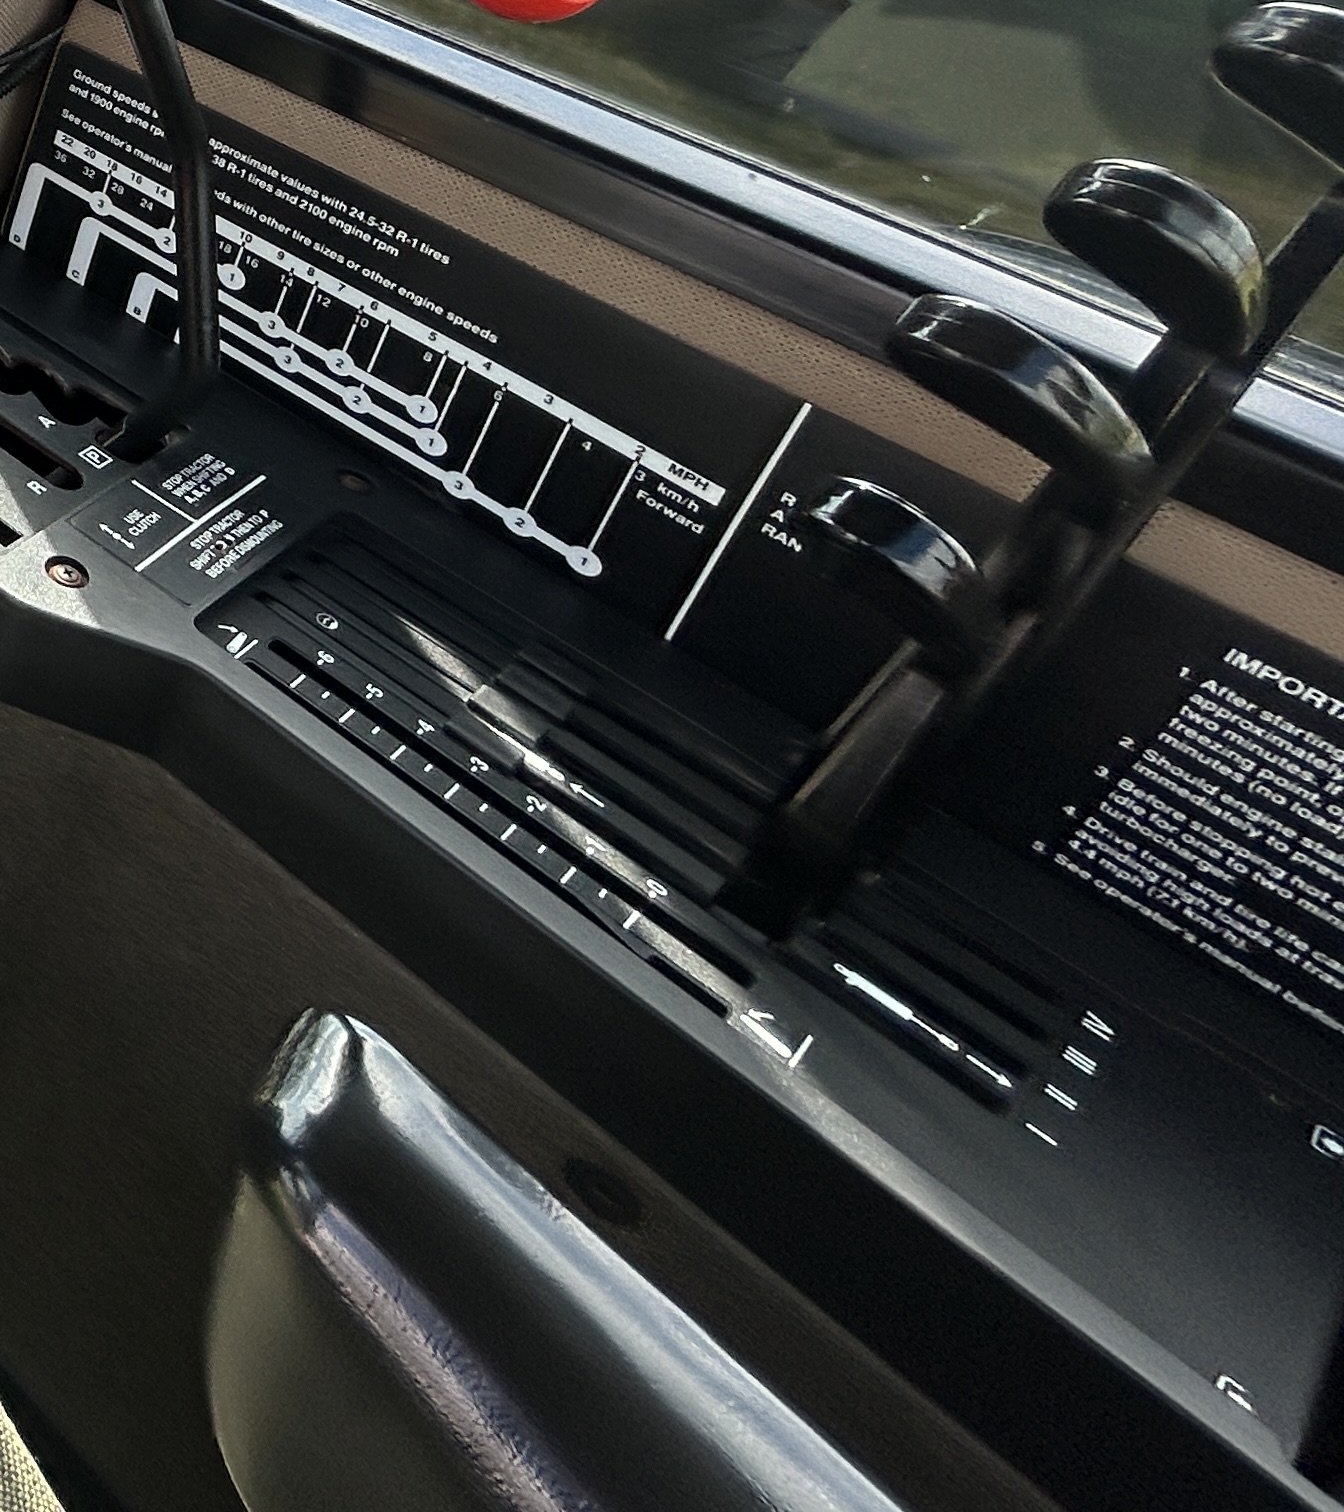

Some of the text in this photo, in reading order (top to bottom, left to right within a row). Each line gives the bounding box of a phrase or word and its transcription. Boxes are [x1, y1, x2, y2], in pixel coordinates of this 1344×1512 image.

[68, 83, 89, 98] and
[89, 92, 113, 110] 1900
[113, 106, 150, 129] engine
[226, 161, 247, 180] R-1
[247, 172, 274, 194] tires
[274, 186, 298, 205] and
[298, 198, 327, 220] 2100
[328, 214, 371, 243] engine
[373, 236, 400, 258] rpm
[73, 68, 451, 265] Ground speeds approximate values with 24.5-32 R-1 tires
[61, 108, 499, 344] See operator's manual with other tire sizes or other engine speeds
[61, 134, 74, 147] 22
[84, 147, 97, 160] 20
[130, 172, 143, 185] 16
[155, 185, 168, 197] 14
[276, 250, 285, 261] 9
[307, 267, 315, 277] 8
[337, 283, 346, 292] 7
[371, 301, 379, 311] 6
[428, 332, 437, 341] 5
[483, 362, 492, 371] 4
[543, 394, 554, 405] 3
[634, 445, 647, 456] 2
[667, 463, 711, 492] MPH
[82, 166, 96, 179] 32
[140, 198, 154, 211] 24
[245, 255, 259, 269] 16
[316, 294, 331, 308] 12
[354, 315, 369, 328] 10
[656, 482, 700, 514] km/h
[38, 415, 57, 429] A
[27, 480, 47, 495] R
[162, 453, 216, 490] STOP TRACTOR
[171, 460, 226, 498] WHEN SHIFTING
[123, 508, 144, 525] USE
[128, 511, 162, 537] CLUTCH
[189, 531, 214, 550] STOP
[211, 509, 245, 534] TRACTOR
[635, 489, 705, 534] Forward
[205, 551, 241, 579] BEFORE
[1169, 717, 1257, 773] freezing
[1180, 705, 1220, 732] two
[1200, 680, 1344, 763] After starting
[1143, 749, 1297, 838] Should engine
[1158, 732, 1287, 806] minutes (no
[1132, 760, 1291, 853] immediately to
[1084, 816, 1187, 882] Drive train
[1117, 778, 1187, 822] Before
[1189, 820, 1287, 880] stopping
[1290, 875, 1332, 903] hot
[1075, 829, 1273, 948] avoiding high loads
[1098, 858, 1145, 888] mph
